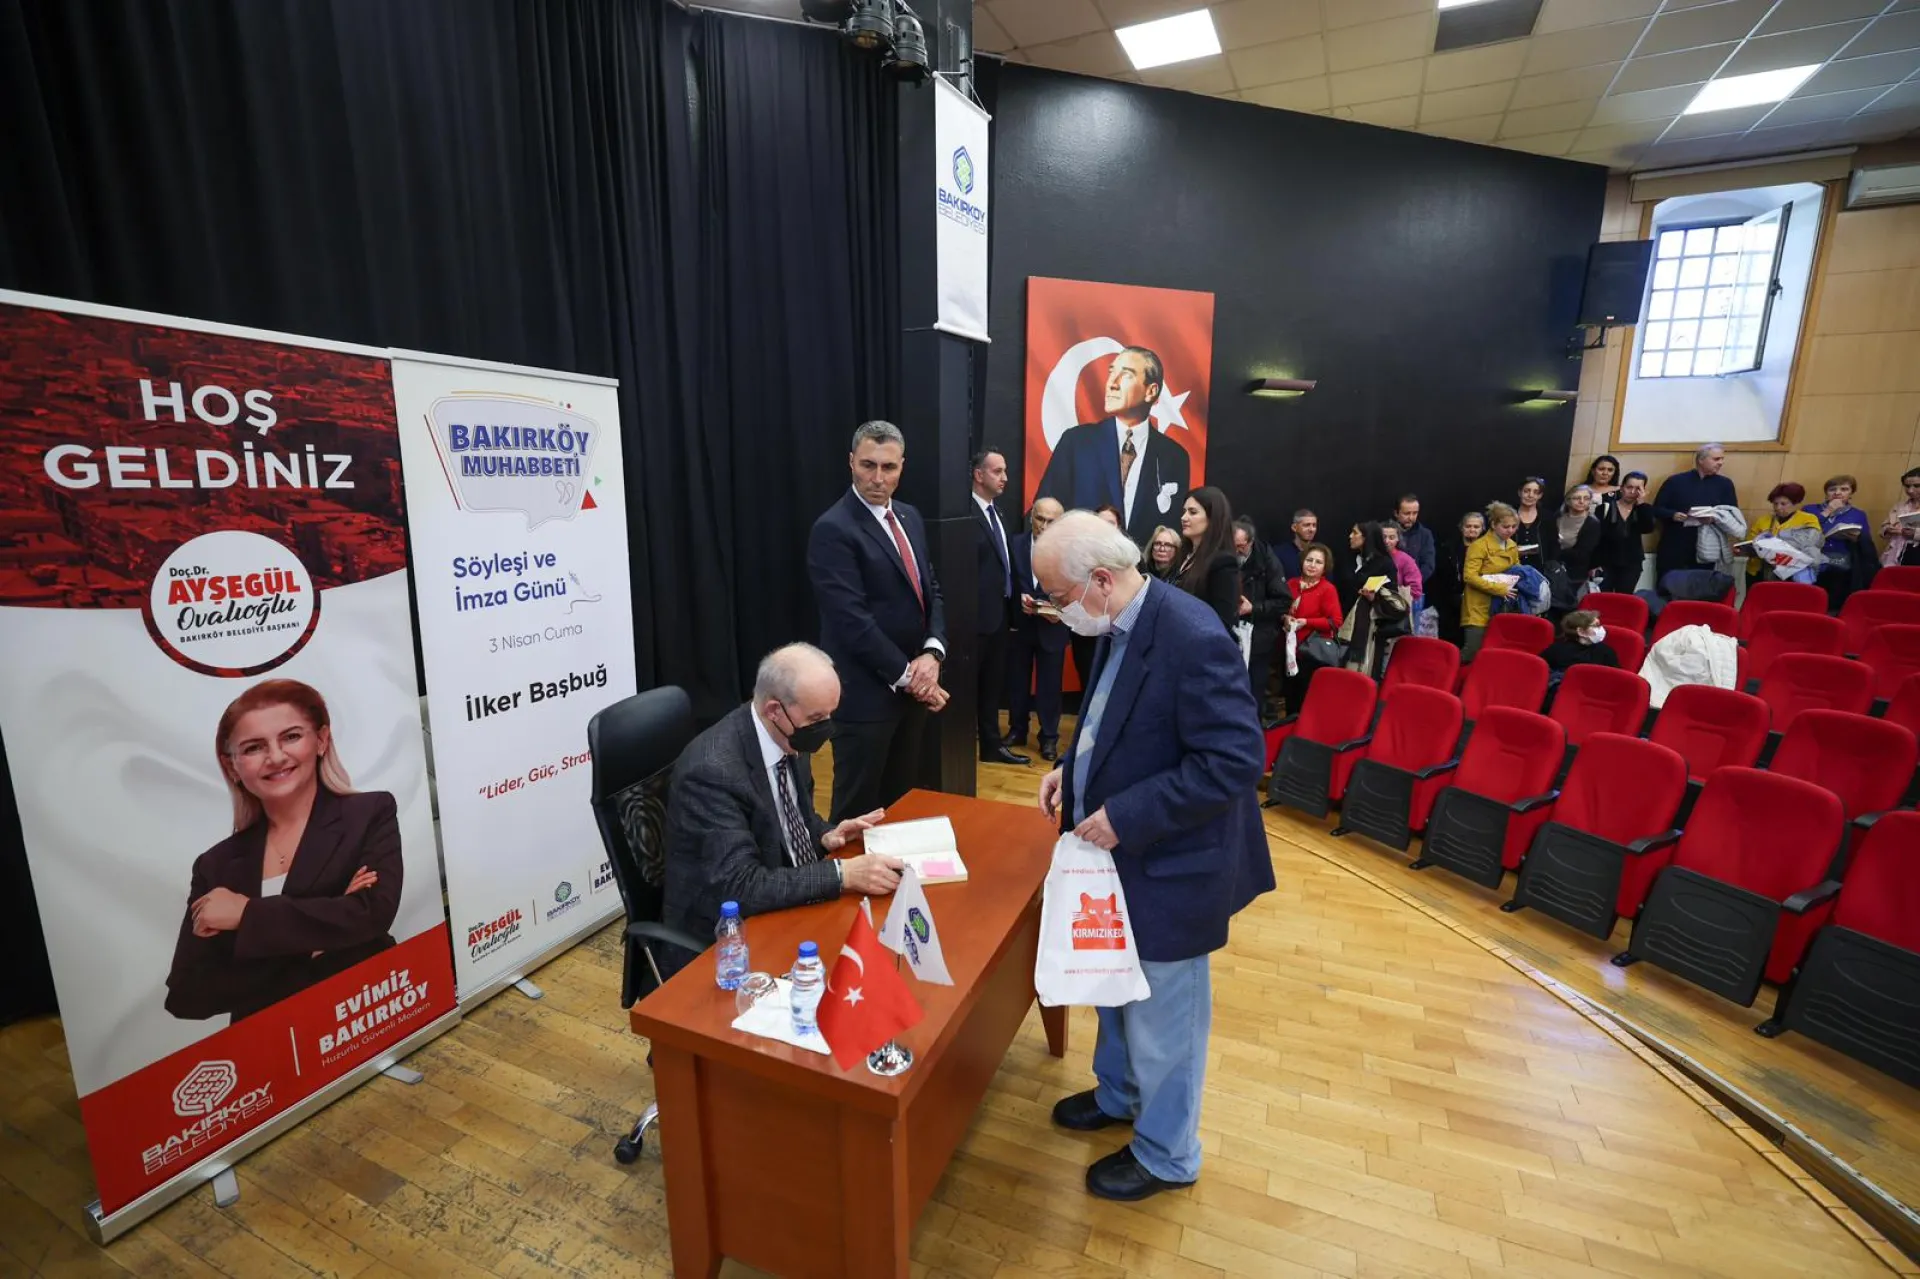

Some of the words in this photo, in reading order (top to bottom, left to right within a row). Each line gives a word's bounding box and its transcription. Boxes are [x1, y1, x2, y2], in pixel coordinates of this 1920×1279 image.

[138, 378, 278, 436] HOŞ
[449, 422, 589, 455] BAKIRKÖY
[43, 441, 355, 490] GELDİNİZ
[461, 453, 580, 477] MUHABBETİ
[453, 551, 528, 578] Söyleşi
[533, 553, 557, 568] ve
[168, 567, 301, 605] AYŞEGÜL
[455, 586, 508, 612] İmza
[514, 578, 567, 601] Günü
[177, 593, 297, 631] Ovalıoğlu
[180, 631, 224, 643] BAKIRKÖY
[226, 624, 265, 637] BELEDİYE
[266, 621, 301, 632] BAŞKANI
[489, 638, 499, 653] 3
[501, 633, 541, 650] Nisan
[544, 624, 583, 641] Cuma
[465, 690, 521, 721] İlker
[529, 664, 608, 704] Başbuğ
[528, 764, 559, 782] Güç,
[467, 908, 523, 947] AYŞEGÜL
[335, 969, 410, 1022] EVİMİZ
[319, 981, 428, 1055] BAKIRKÖY
[321, 1042, 360, 1068] Huzurlu
[361, 1022, 396, 1045] Güvenli
[397, 1002, 431, 1024] Modern
